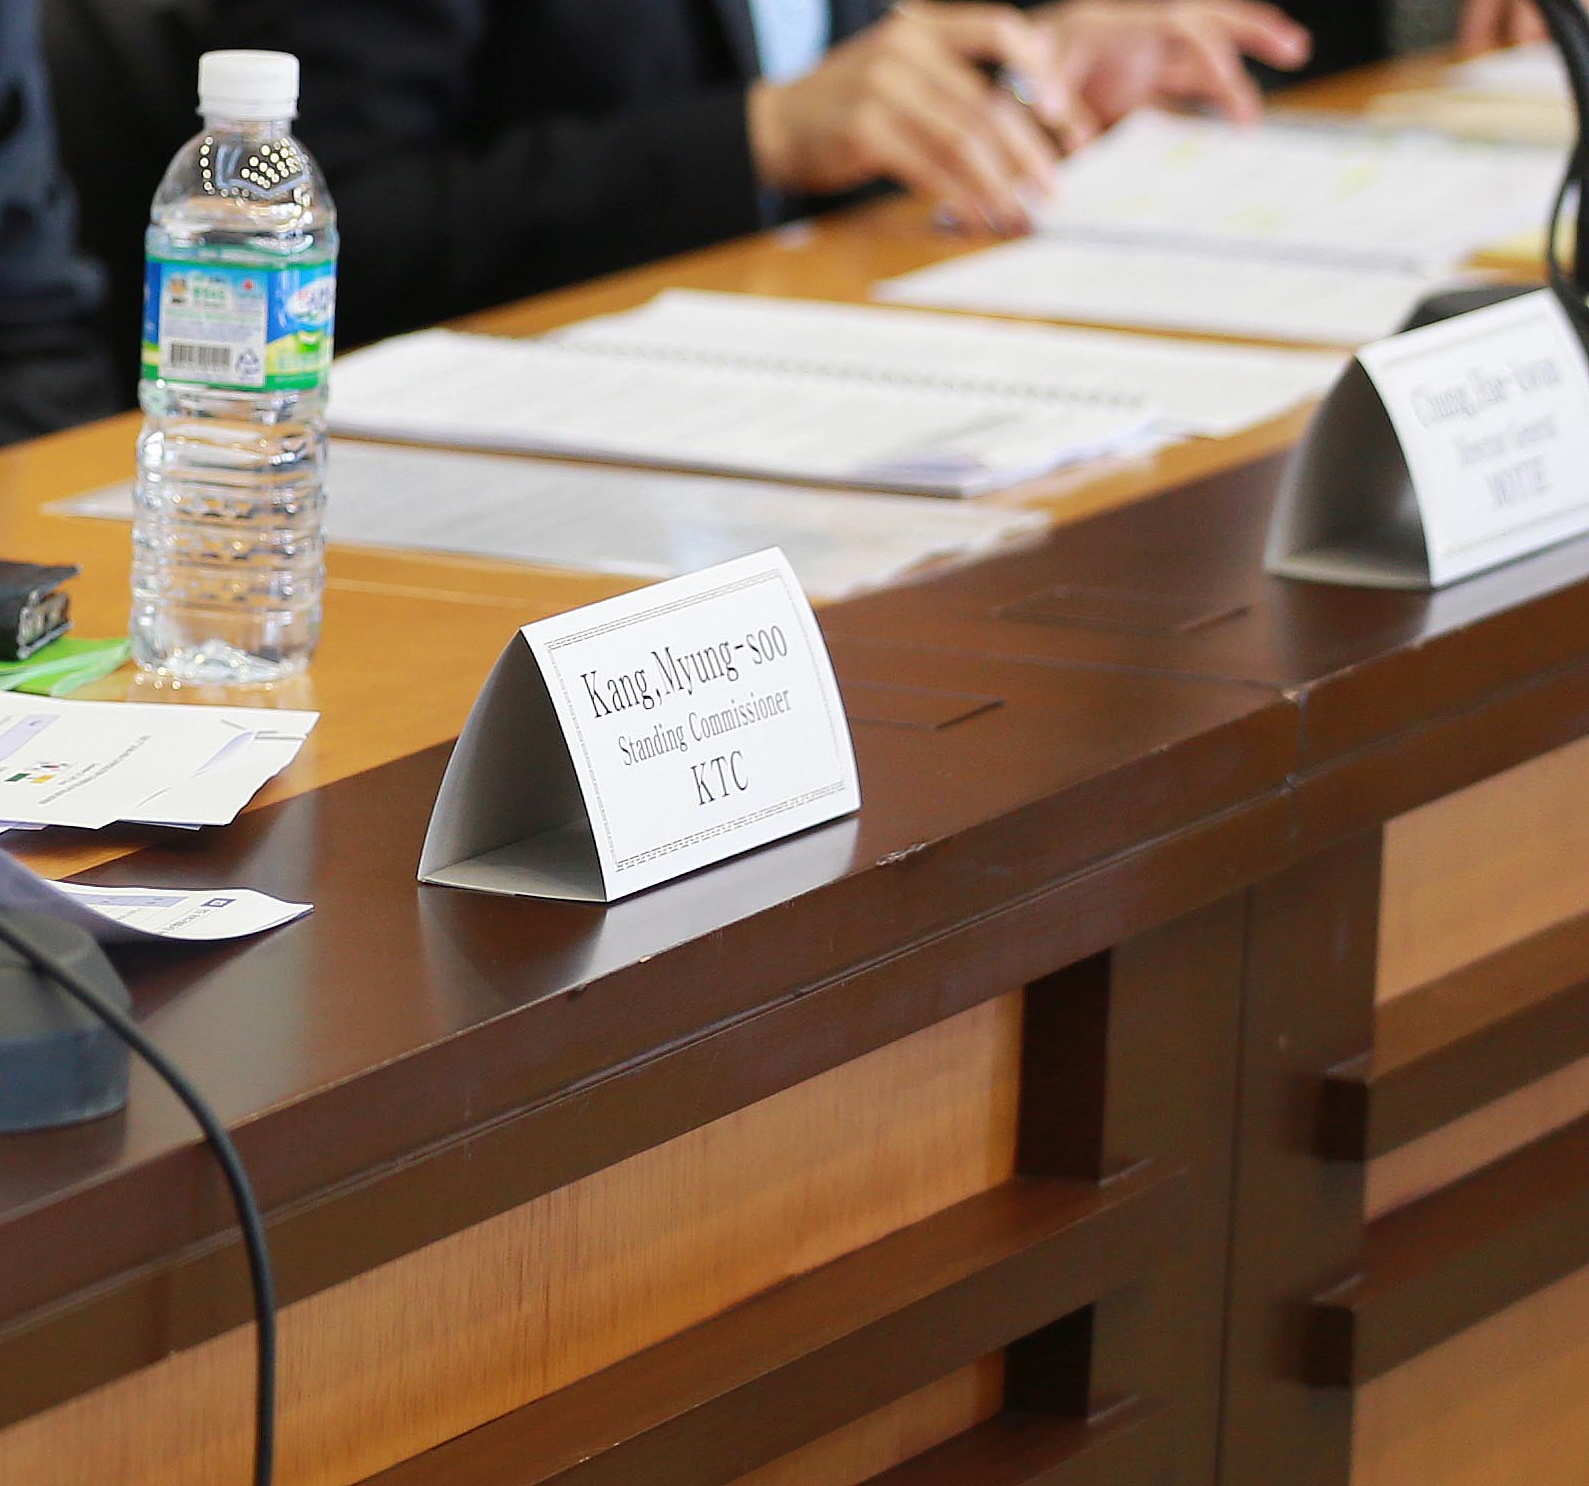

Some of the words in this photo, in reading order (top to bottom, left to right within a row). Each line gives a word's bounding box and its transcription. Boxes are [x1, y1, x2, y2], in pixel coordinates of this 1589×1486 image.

[618, 722, 688, 766] Standing
[688, 691, 791, 742] Commissioner
[690, 750, 749, 805] KTC
